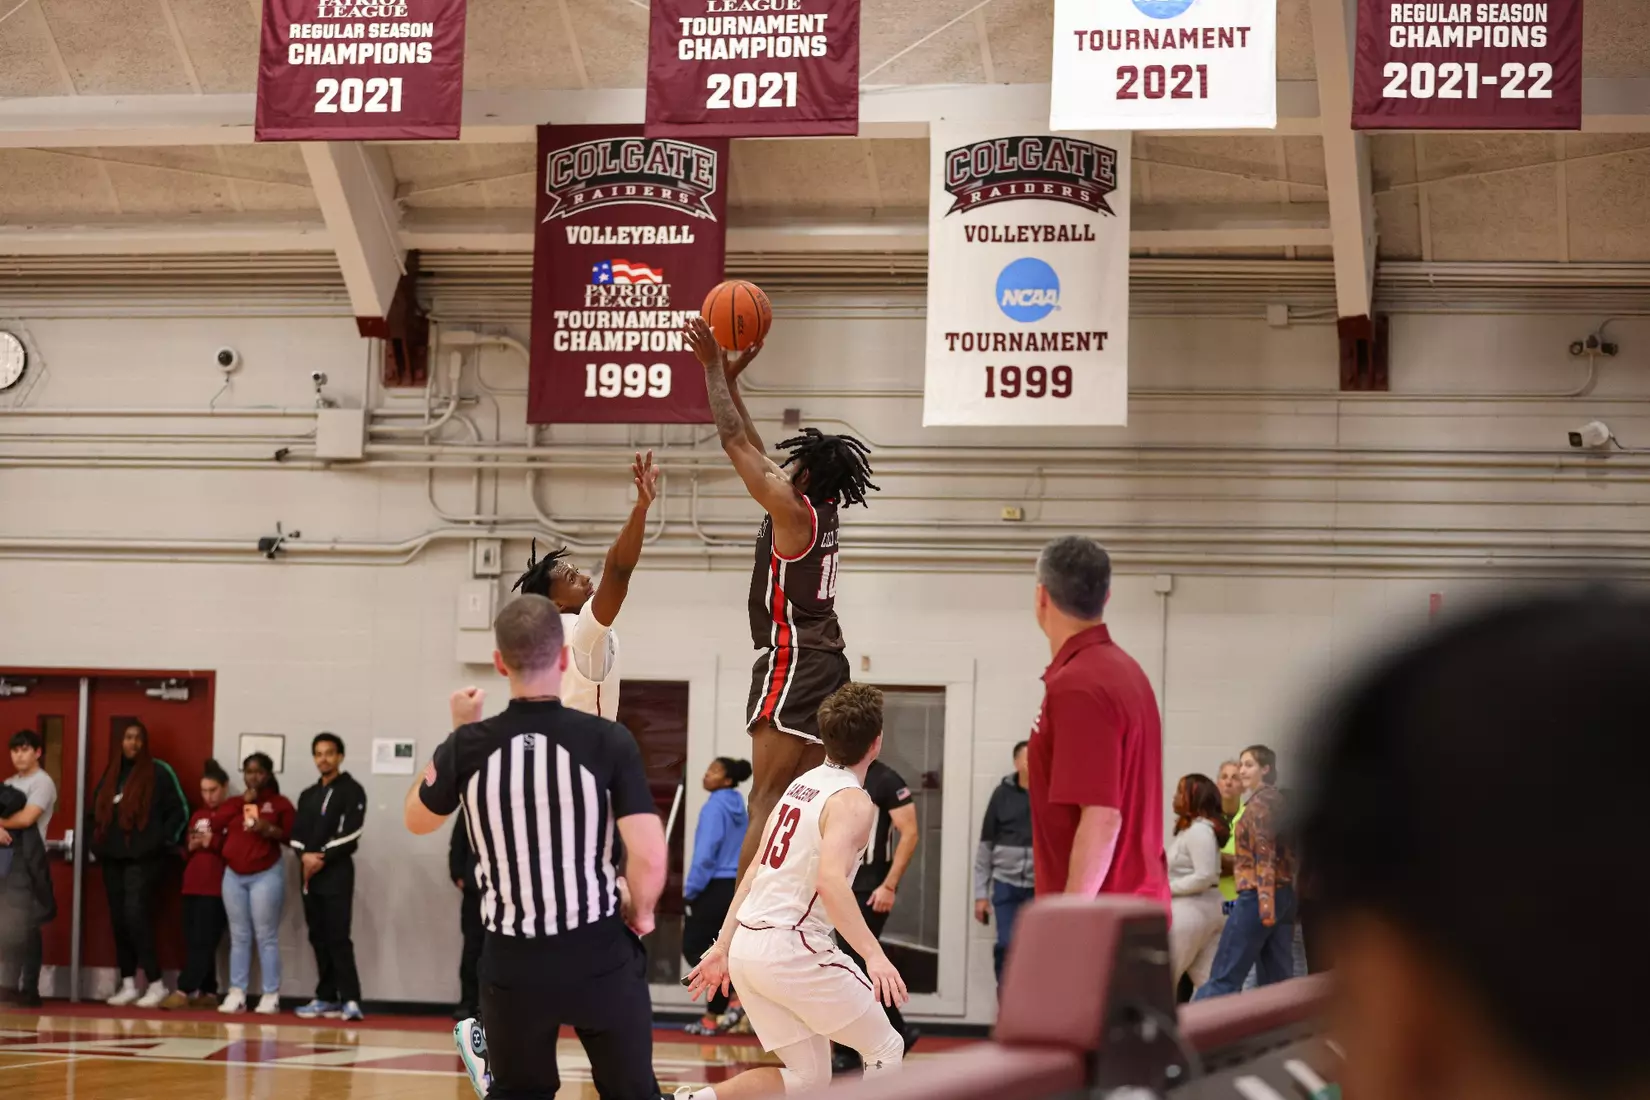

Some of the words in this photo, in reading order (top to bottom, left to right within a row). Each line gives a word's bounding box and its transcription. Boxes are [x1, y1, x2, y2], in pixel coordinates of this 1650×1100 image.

[317, 5, 408, 18] LEAGUE
[706, 0, 801, 13] LEAGUE
[1391, 3, 1473, 24] REGULAR
[1476, 3, 1548, 23] SEASON
[289, 23, 365, 39] REGULAR
[368, 22, 434, 38] SEASON
[678, 13, 829, 36] TOURNAMENT
[678, 35, 828, 61] CHAMPIONS
[1074, 26, 1251, 52] TOURNAMENT
[1389, 25, 1548, 49] CHAMPIONS
[288, 42, 434, 66] CHAMPIONS
[706, 71, 798, 110] 2021
[1115, 64, 1209, 100] 2021
[1382, 62, 1553, 100] 2021-22
[314, 77, 404, 113] 2021
[552, 140, 714, 188] COLGATE
[948, 137, 1115, 187] COLGATE
[573, 185, 690, 206] RAIDERS
[970, 183, 1091, 203] RAIDERS
[565, 225, 696, 246] VOLLEYBALL
[964, 224, 1096, 243] VOLLEYBALL
[583, 295, 671, 308] LEAGUE
[584, 284, 672, 297] PATRIOT
[1001, 288, 1060, 307] NCAA
[553, 310, 700, 329] TOURNAMENT
[945, 332, 1109, 353] TOURNAMENT
[584, 363, 673, 399] 1999
[984, 365, 1074, 399] 1999
[760, 803, 801, 870] 13
